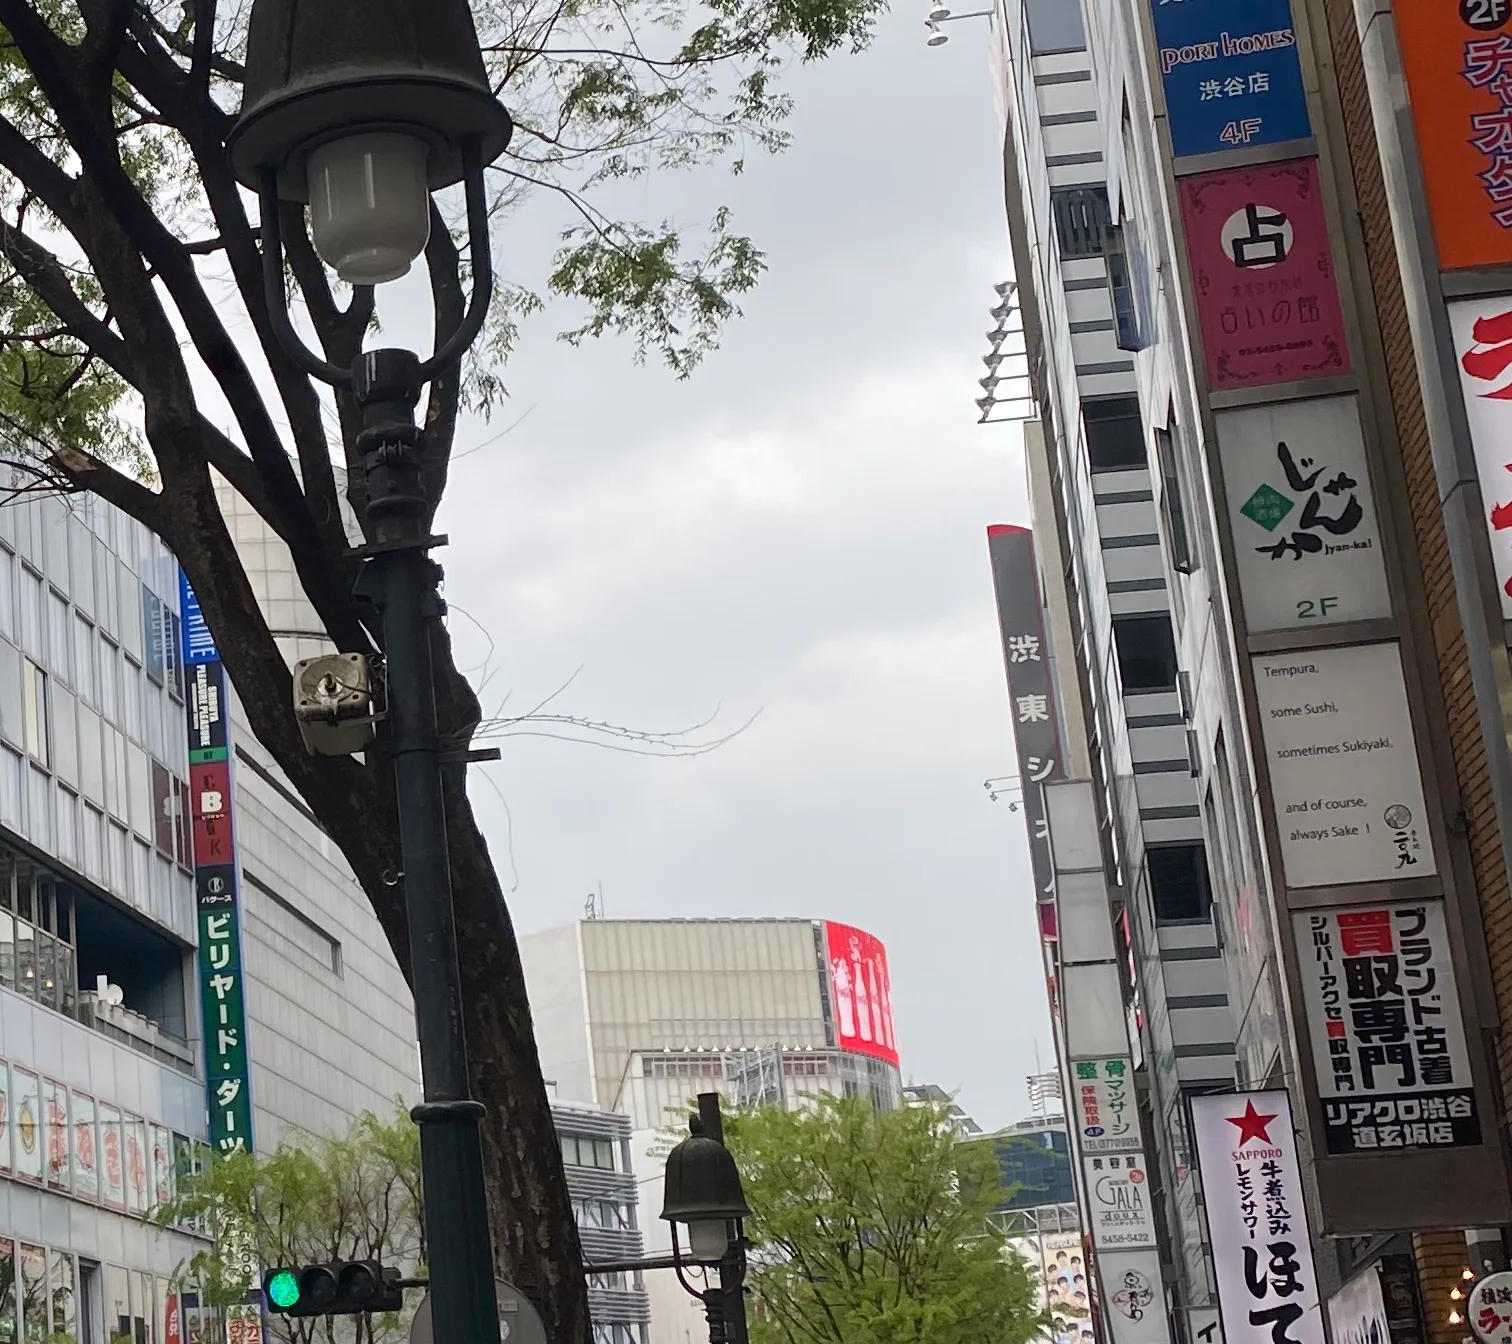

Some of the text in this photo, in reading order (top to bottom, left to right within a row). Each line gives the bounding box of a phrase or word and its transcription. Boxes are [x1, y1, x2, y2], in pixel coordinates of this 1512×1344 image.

[1199, 71, 1271, 102] 渋谷店
[1219, 116, 1263, 145] 4F
[1232, 203, 1287, 268] 占
[1296, 596, 1339, 619] 2F
[1271, 706, 1303, 719] some
[1276, 743, 1340, 760] sometimes
[1286, 801, 1309, 814] and
[1311, 799, 1324, 812] of
[1290, 826, 1330, 842] always
[1332, 825, 1360, 838] Sake
[1336, 910, 1418, 1091] 買取専門
[1394, 906, 1455, 1086] ブランド古着
[1104, 1079, 1130, 1136] マッサージ
[1326, 1095, 1473, 1127] リアクロ渋谷
[1351, 1121, 1456, 1150] 道玄坂店
[1231, 1148, 1283, 1162] SAPPORO
[1096, 1176, 1144, 1209] GALA
[1235, 1163, 1259, 1239] レモンサワー
[1261, 1160, 1292, 1235] 牛煮込み
